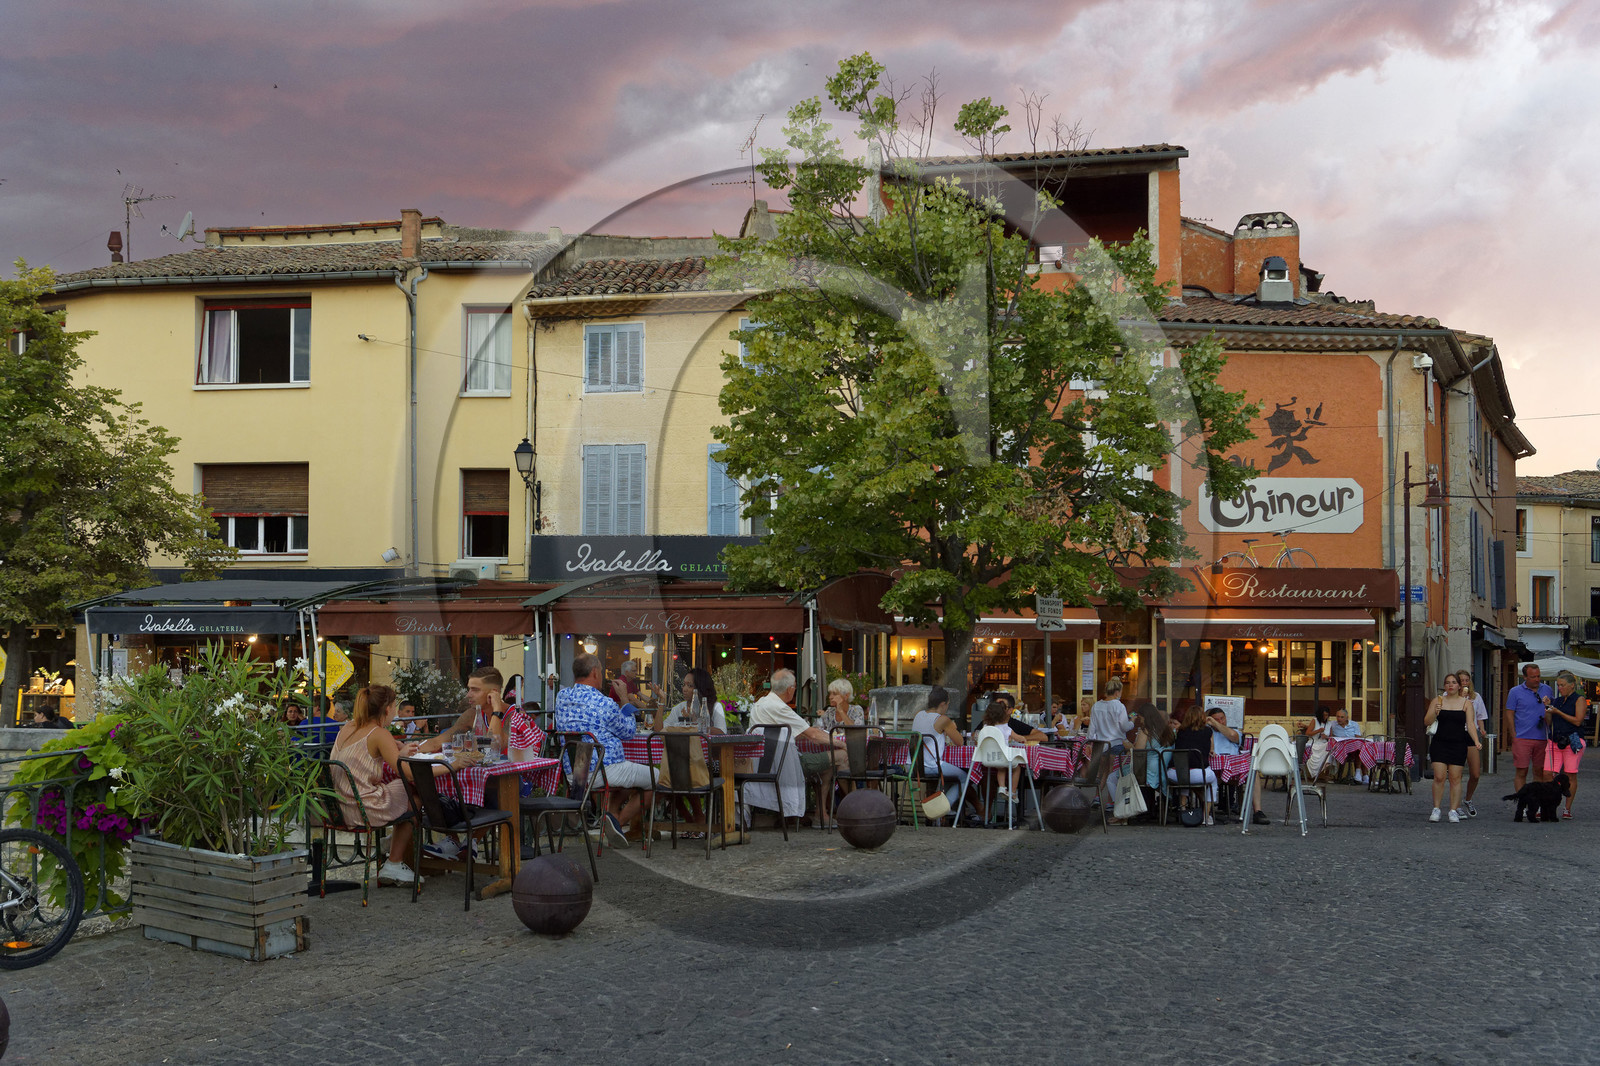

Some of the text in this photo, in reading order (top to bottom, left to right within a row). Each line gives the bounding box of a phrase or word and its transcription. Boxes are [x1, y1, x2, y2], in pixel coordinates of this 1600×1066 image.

[1210, 484, 1355, 528] Chineur
[566, 543, 728, 573] Isabella GELATE
[1223, 572, 1367, 599] Restaurant
[1039, 599, 1062, 607] TRANSPORT
[139, 613, 197, 632] Isabella
[395, 615, 453, 632] Bistrot
[623, 612, 729, 631] Au Chineur
[1235, 625, 1305, 637] Au Chineur
